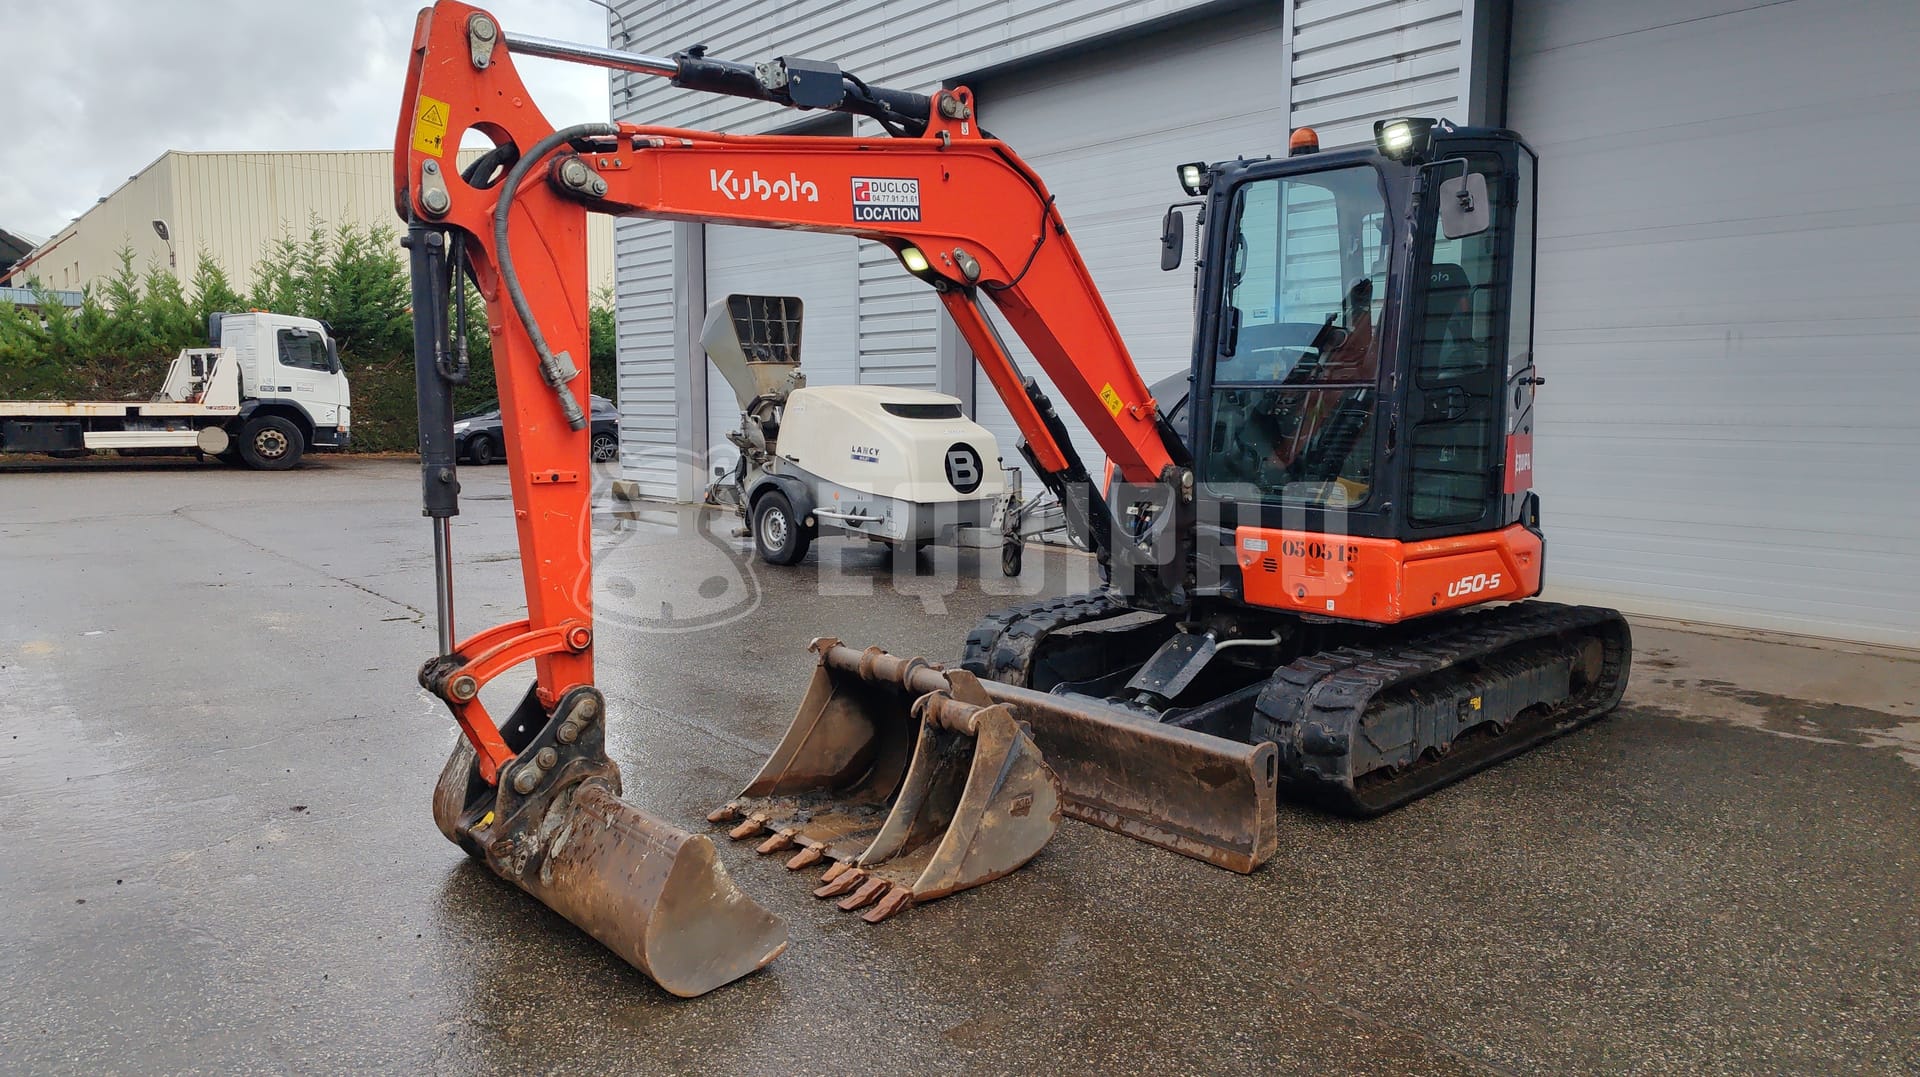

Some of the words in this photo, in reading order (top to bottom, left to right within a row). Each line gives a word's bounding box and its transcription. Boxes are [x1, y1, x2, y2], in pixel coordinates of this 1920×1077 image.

[710, 168, 818, 202] Kubota
[871, 182, 917, 193] DUCLOS
[855, 207, 919, 221] LOCATION
